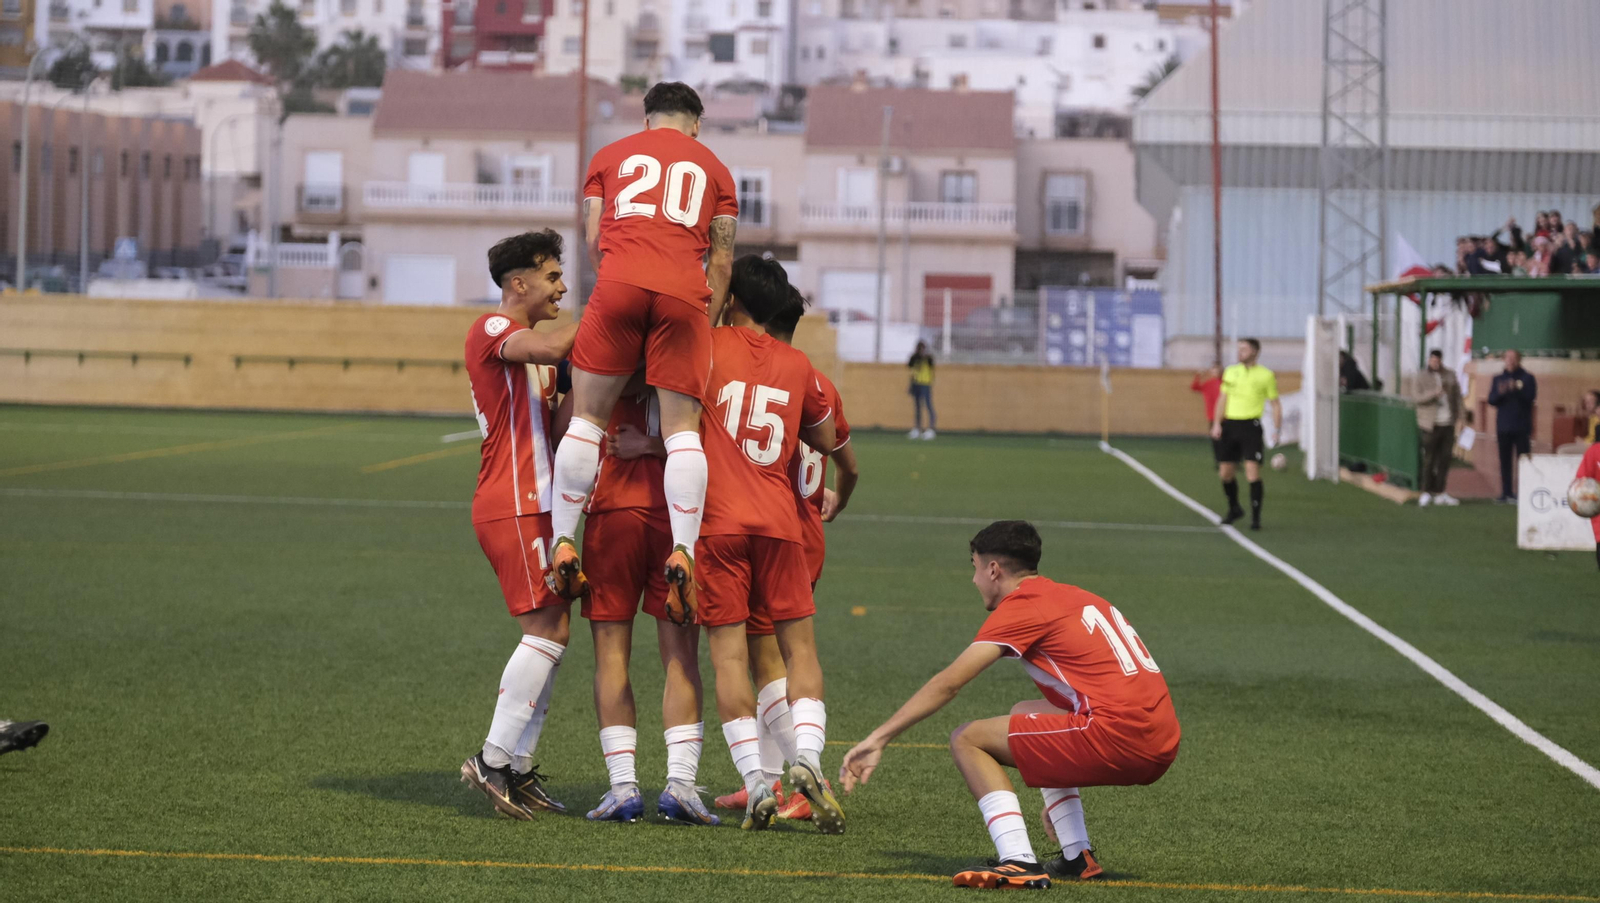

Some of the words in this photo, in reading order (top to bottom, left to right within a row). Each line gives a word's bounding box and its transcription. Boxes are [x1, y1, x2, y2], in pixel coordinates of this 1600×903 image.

[614, 154, 707, 228] 20
[717, 380, 790, 466] 15
[1081, 604, 1160, 676] 16
